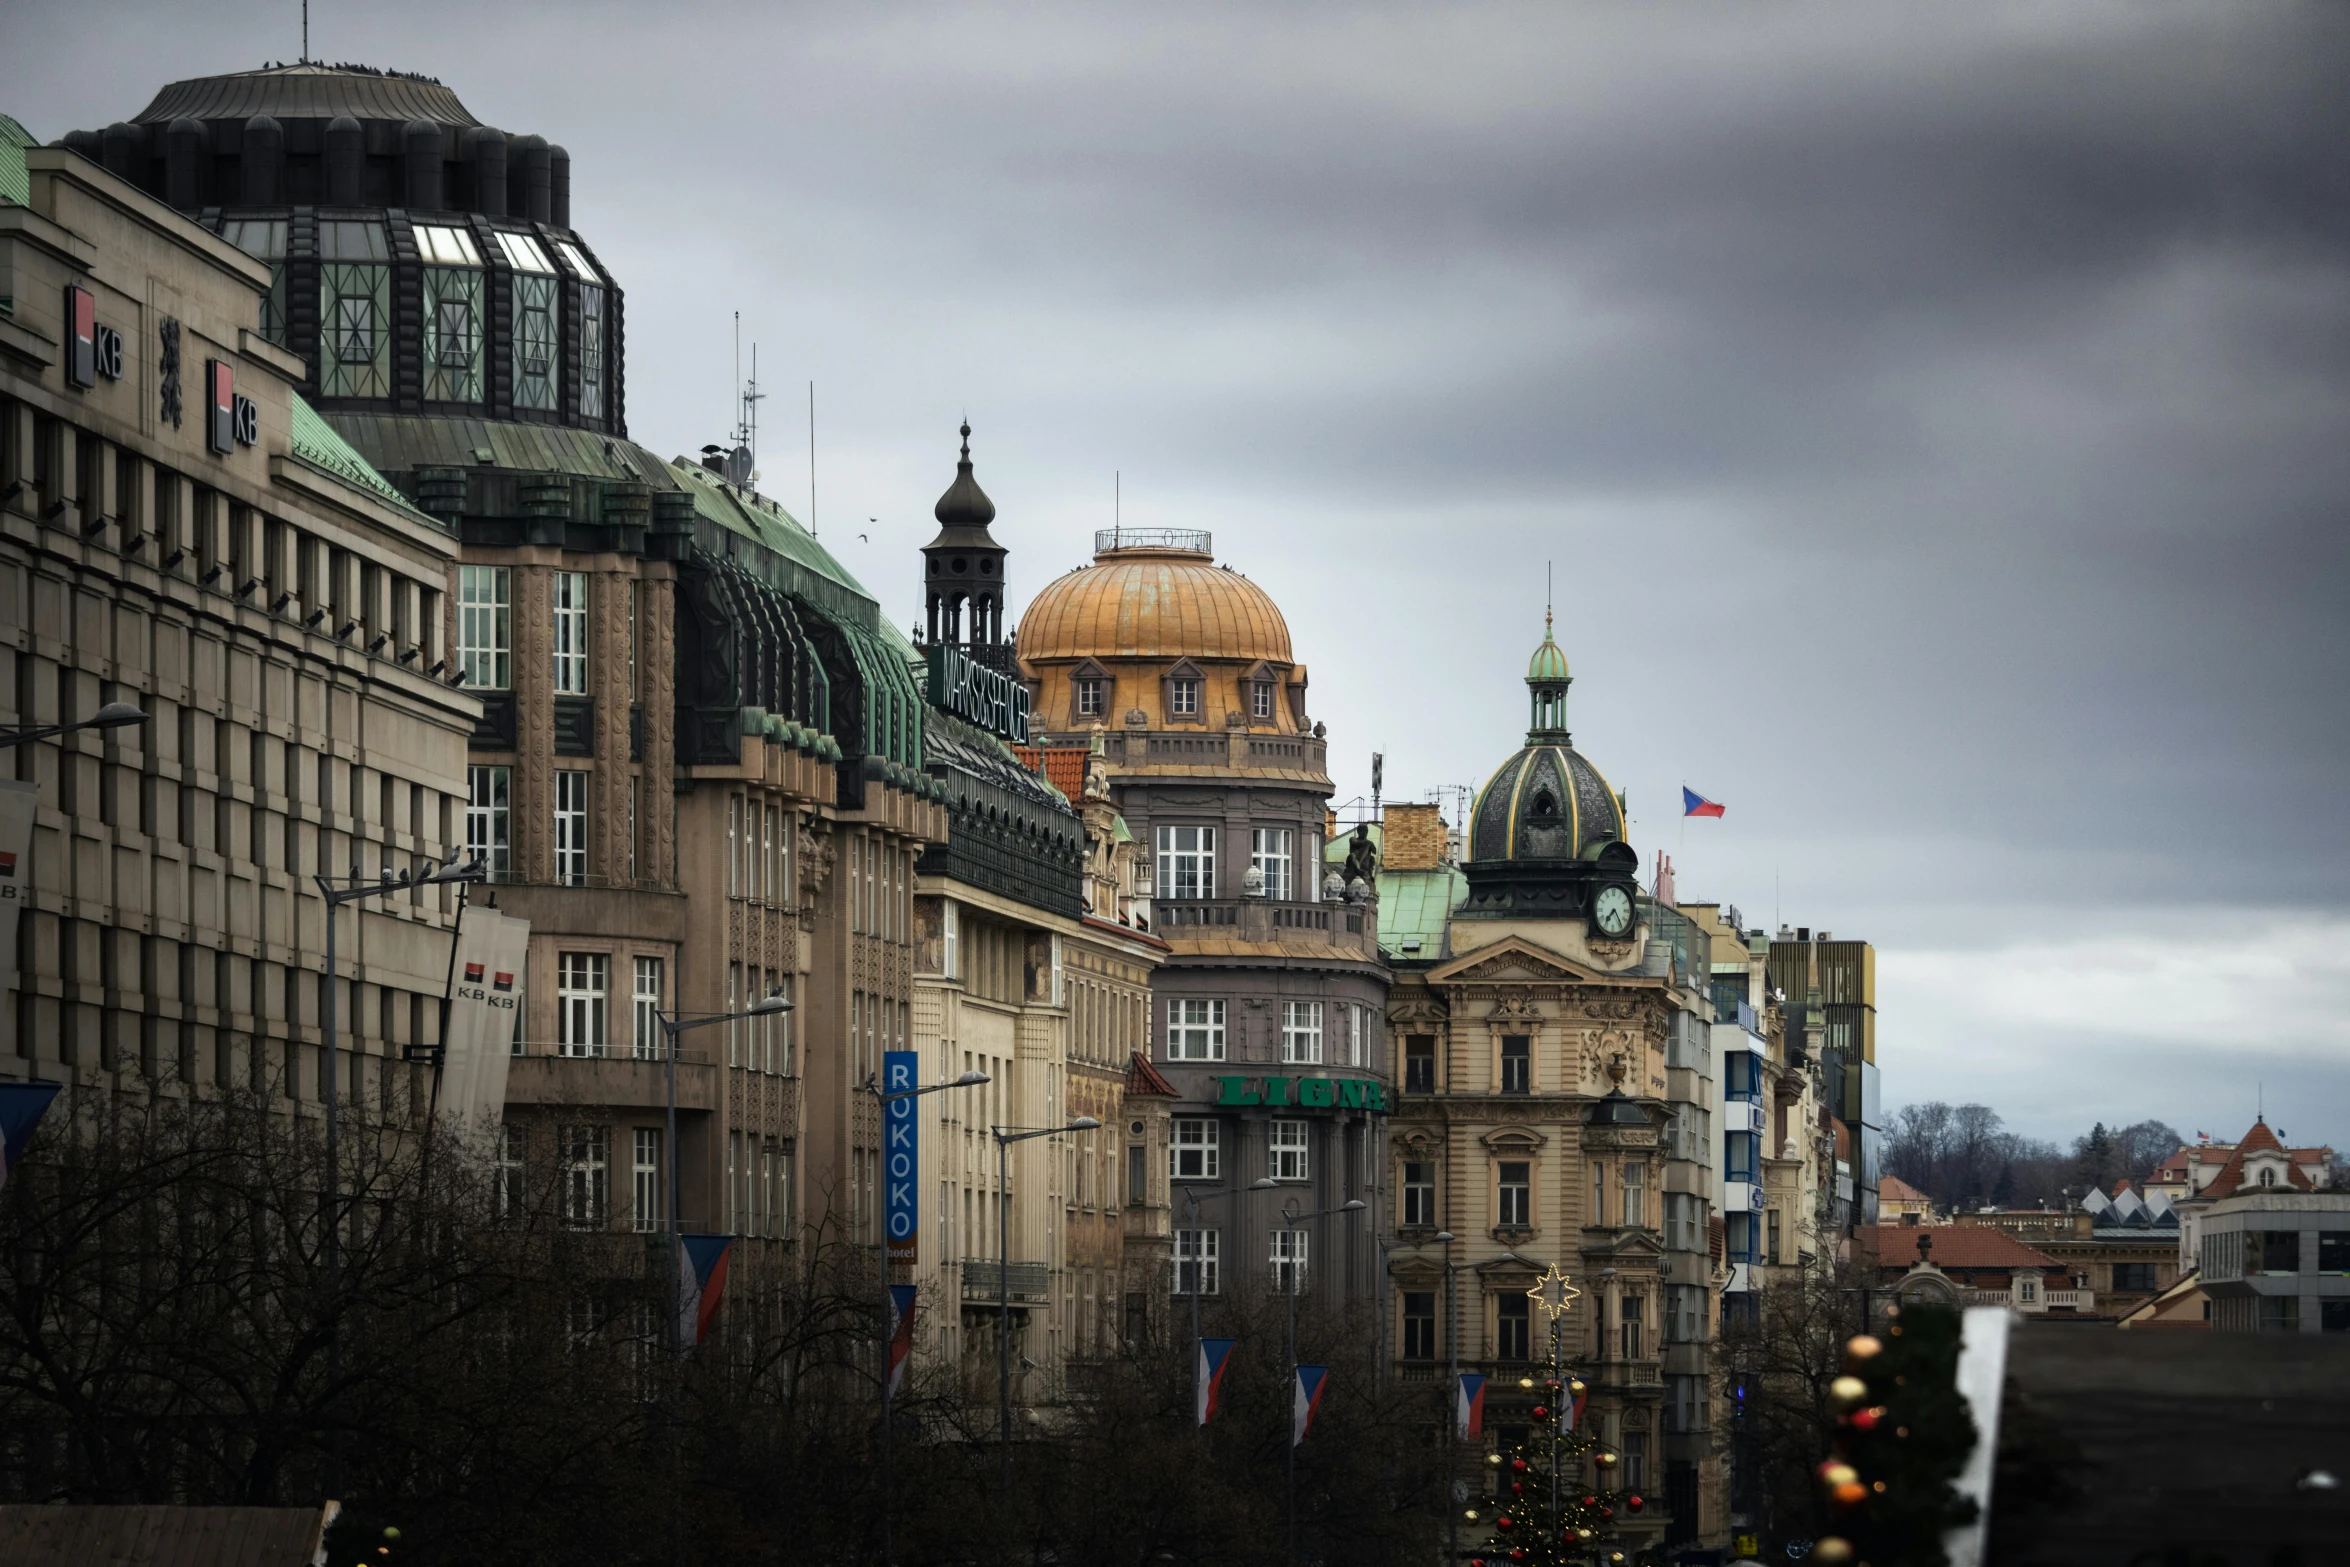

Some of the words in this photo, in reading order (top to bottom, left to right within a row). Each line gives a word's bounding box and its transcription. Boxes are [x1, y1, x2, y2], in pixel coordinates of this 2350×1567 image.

[97, 323, 123, 380] KB
[236, 394, 258, 446] KB
[457, 986, 485, 1001] KB
[487, 995, 514, 1010] KB
[1217, 1075, 1384, 1112] LIGNA
[890, 1064, 911, 1237] ROKOKO
[887, 1246, 915, 1258] hotel
